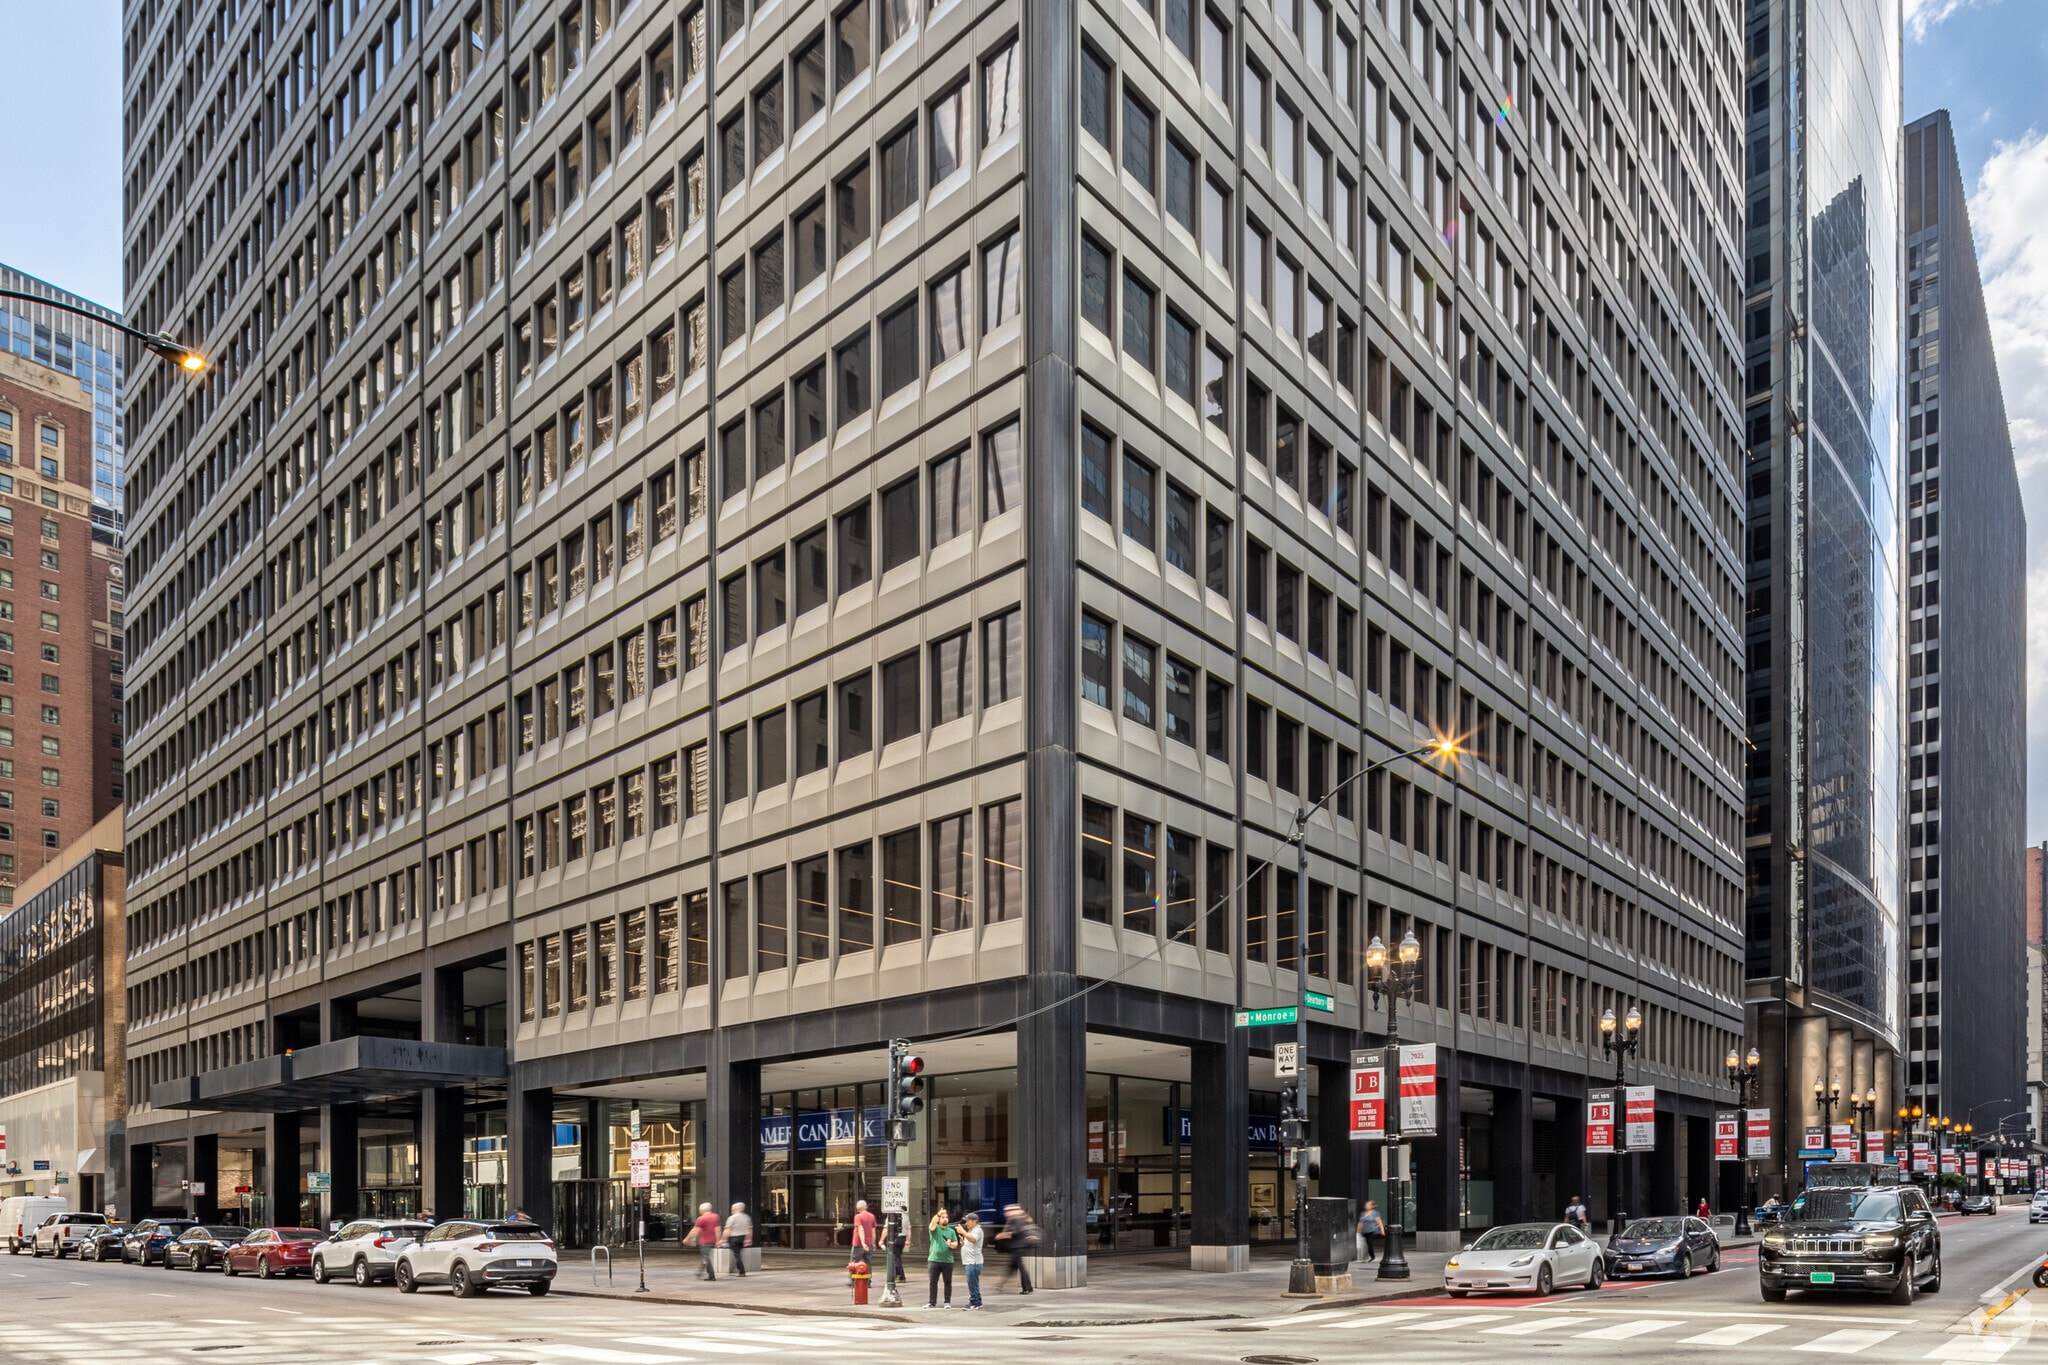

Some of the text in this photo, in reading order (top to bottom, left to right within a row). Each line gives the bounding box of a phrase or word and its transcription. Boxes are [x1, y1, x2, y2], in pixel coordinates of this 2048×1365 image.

[1255, 1012, 1288, 1022] Monroe
[1278, 1046, 1294, 1055] ONE
[1278, 1055, 1295, 1063] WAY
[760, 1123, 829, 1145] MECAN
